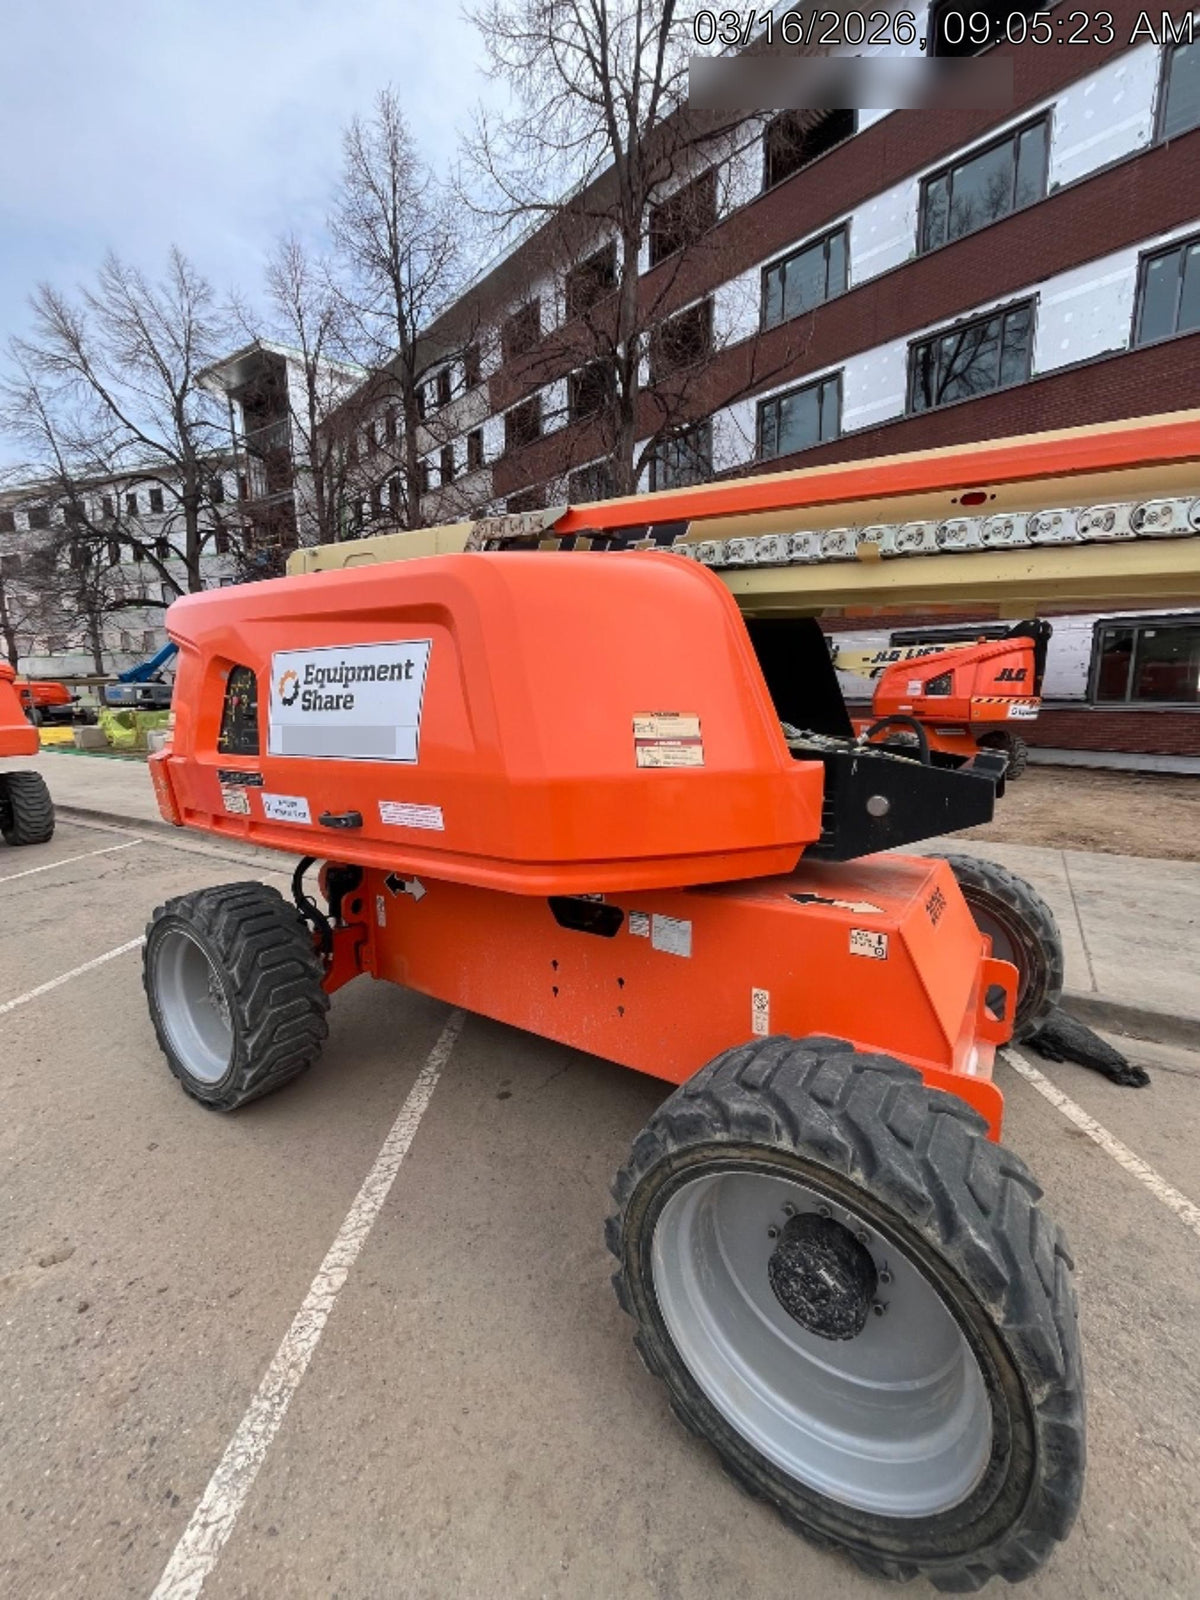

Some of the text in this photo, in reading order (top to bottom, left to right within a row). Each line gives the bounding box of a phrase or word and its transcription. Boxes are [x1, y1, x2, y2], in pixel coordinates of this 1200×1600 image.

[871, 649, 902, 663] JLG
[303, 659, 415, 688] Equipment
[994, 668, 1028, 681] JLG
[301, 689, 355, 712] Share
